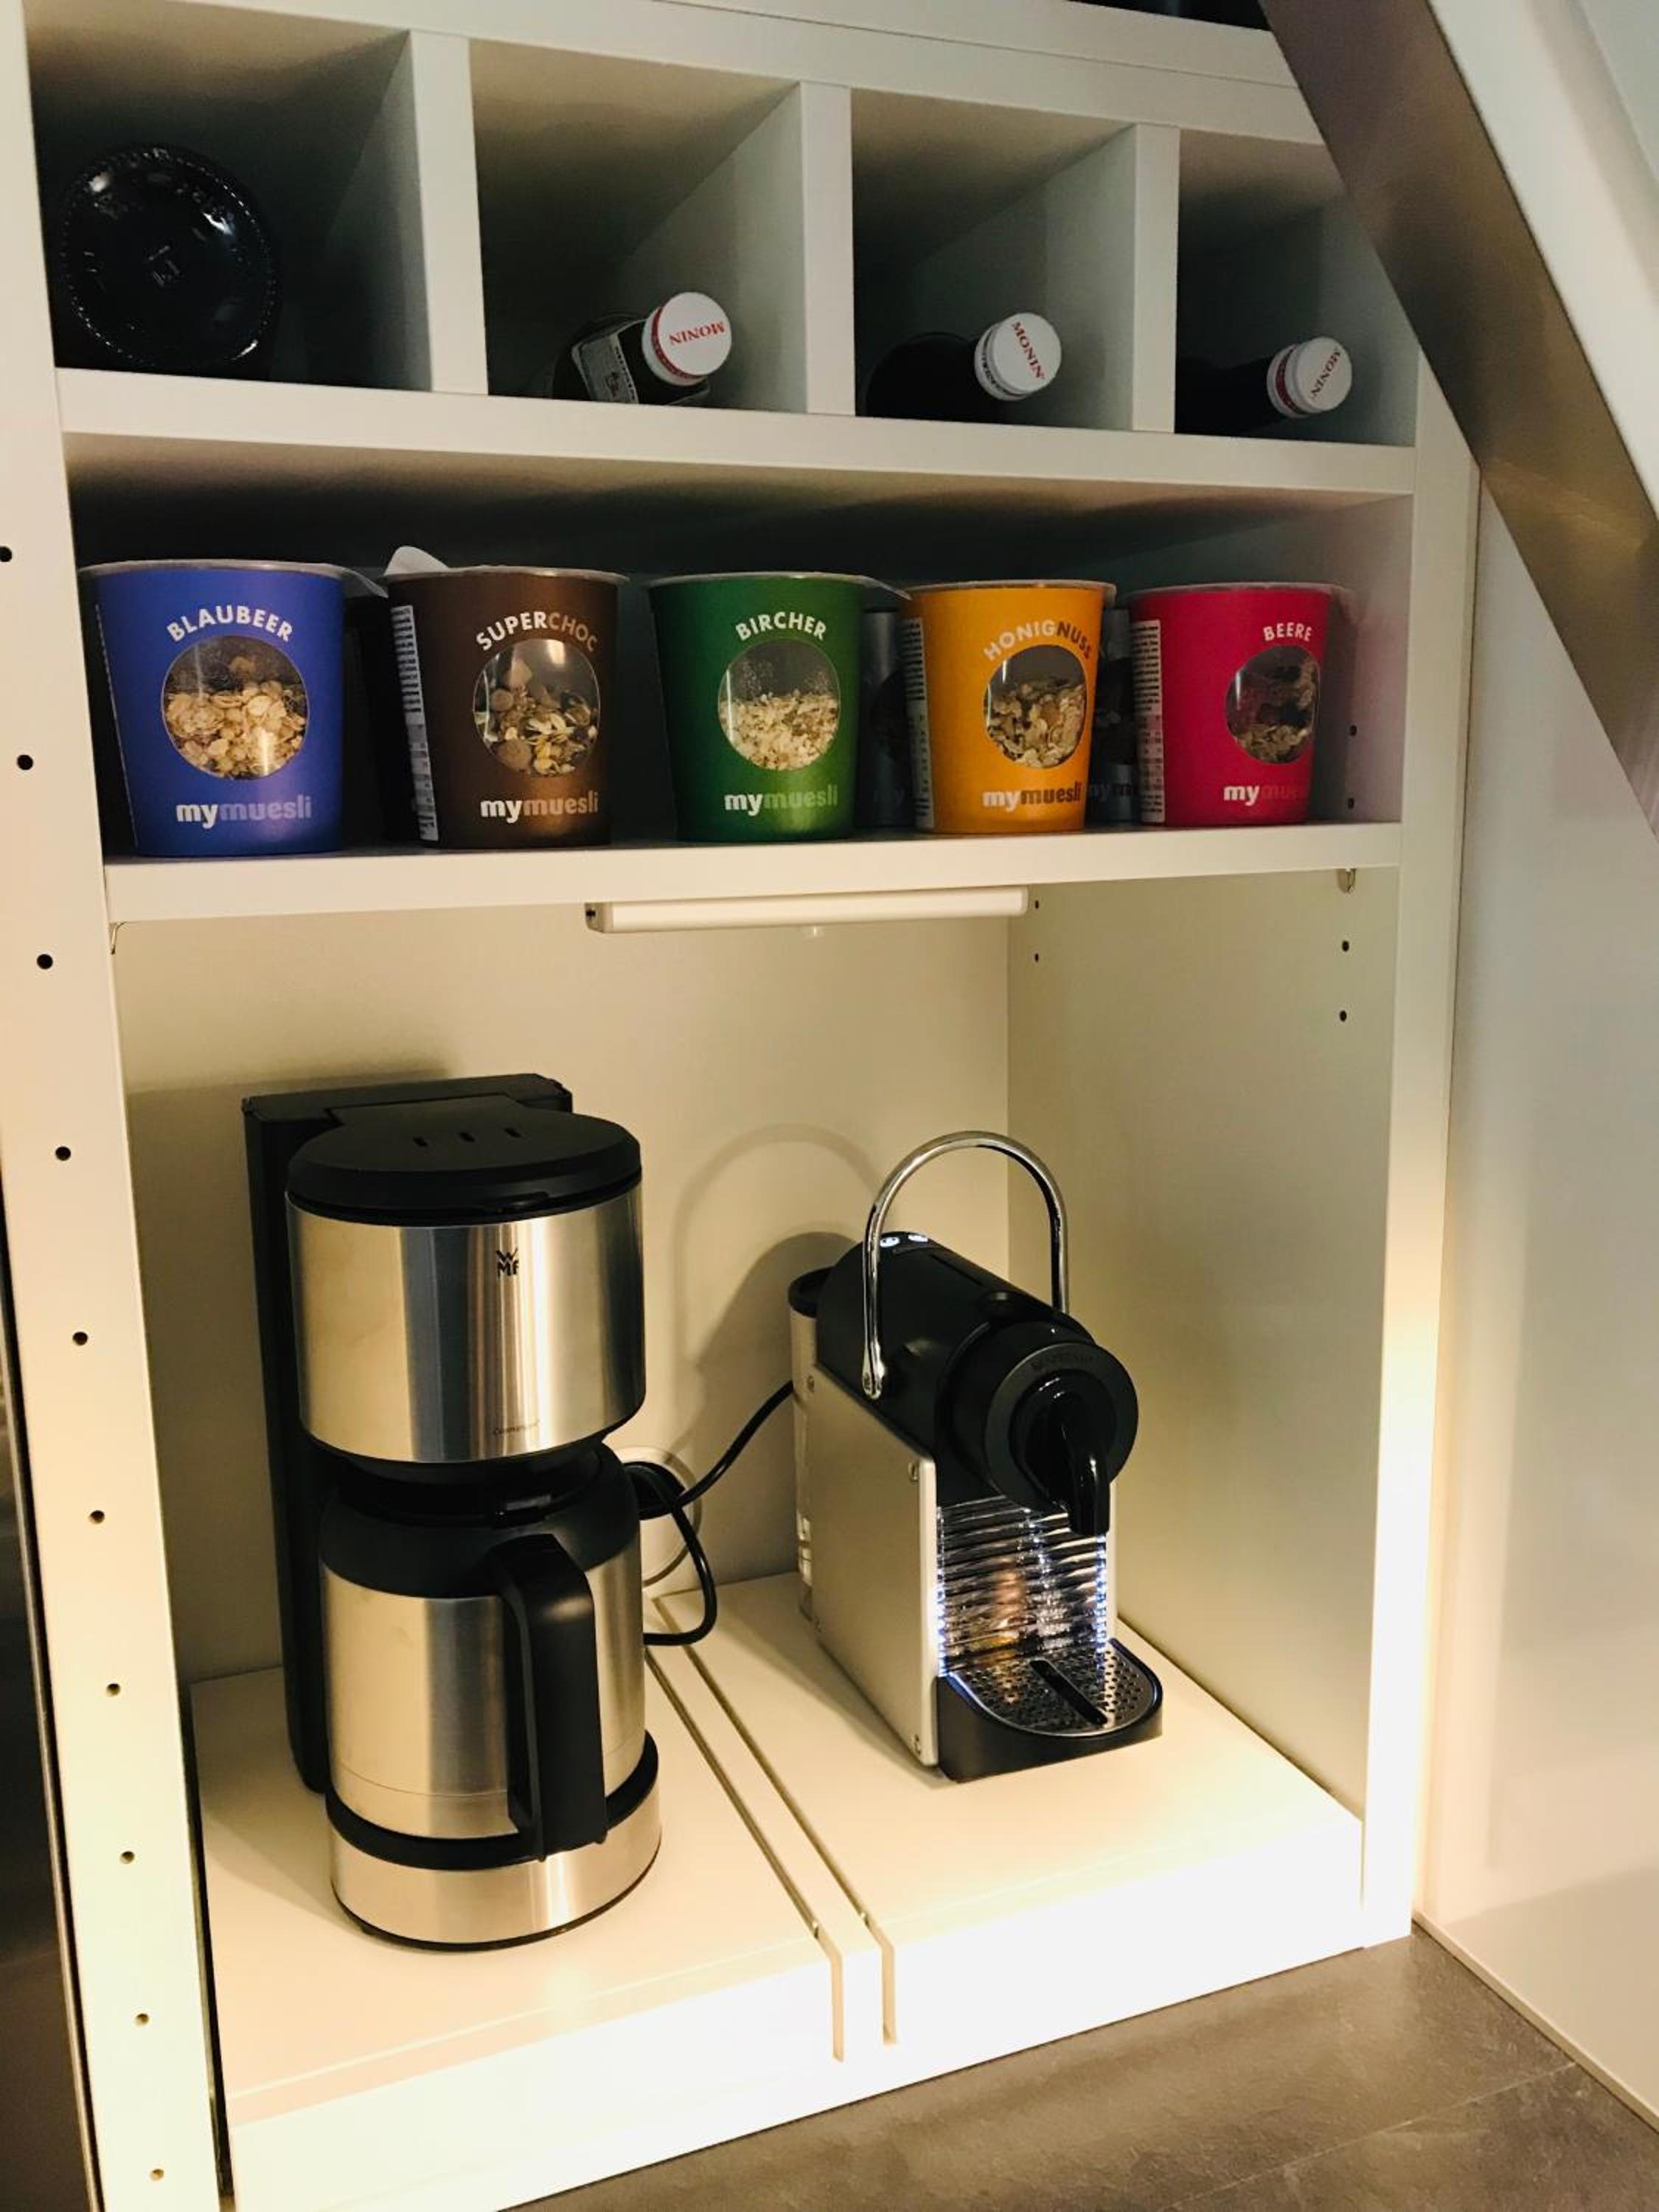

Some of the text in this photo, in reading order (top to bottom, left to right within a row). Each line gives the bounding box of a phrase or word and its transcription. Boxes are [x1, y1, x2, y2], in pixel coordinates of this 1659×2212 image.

[669, 321, 726, 346] MONIN
[1012, 321, 1046, 379] MONIN
[1311, 348, 1341, 399] MONIN
[167, 605, 293, 642] BLAUBEER
[476, 611, 599, 652] SUPERCHOC
[735, 611, 827, 641] BIRCHER
[983, 619, 1091, 660] HONIGNUSS
[1263, 622, 1312, 642] BEERE
[176, 796, 312, 829] mymuesli
[480, 790, 598, 824] mymuesli
[725, 785, 838, 816] mymuesli
[982, 782, 1082, 813] mymuesli
